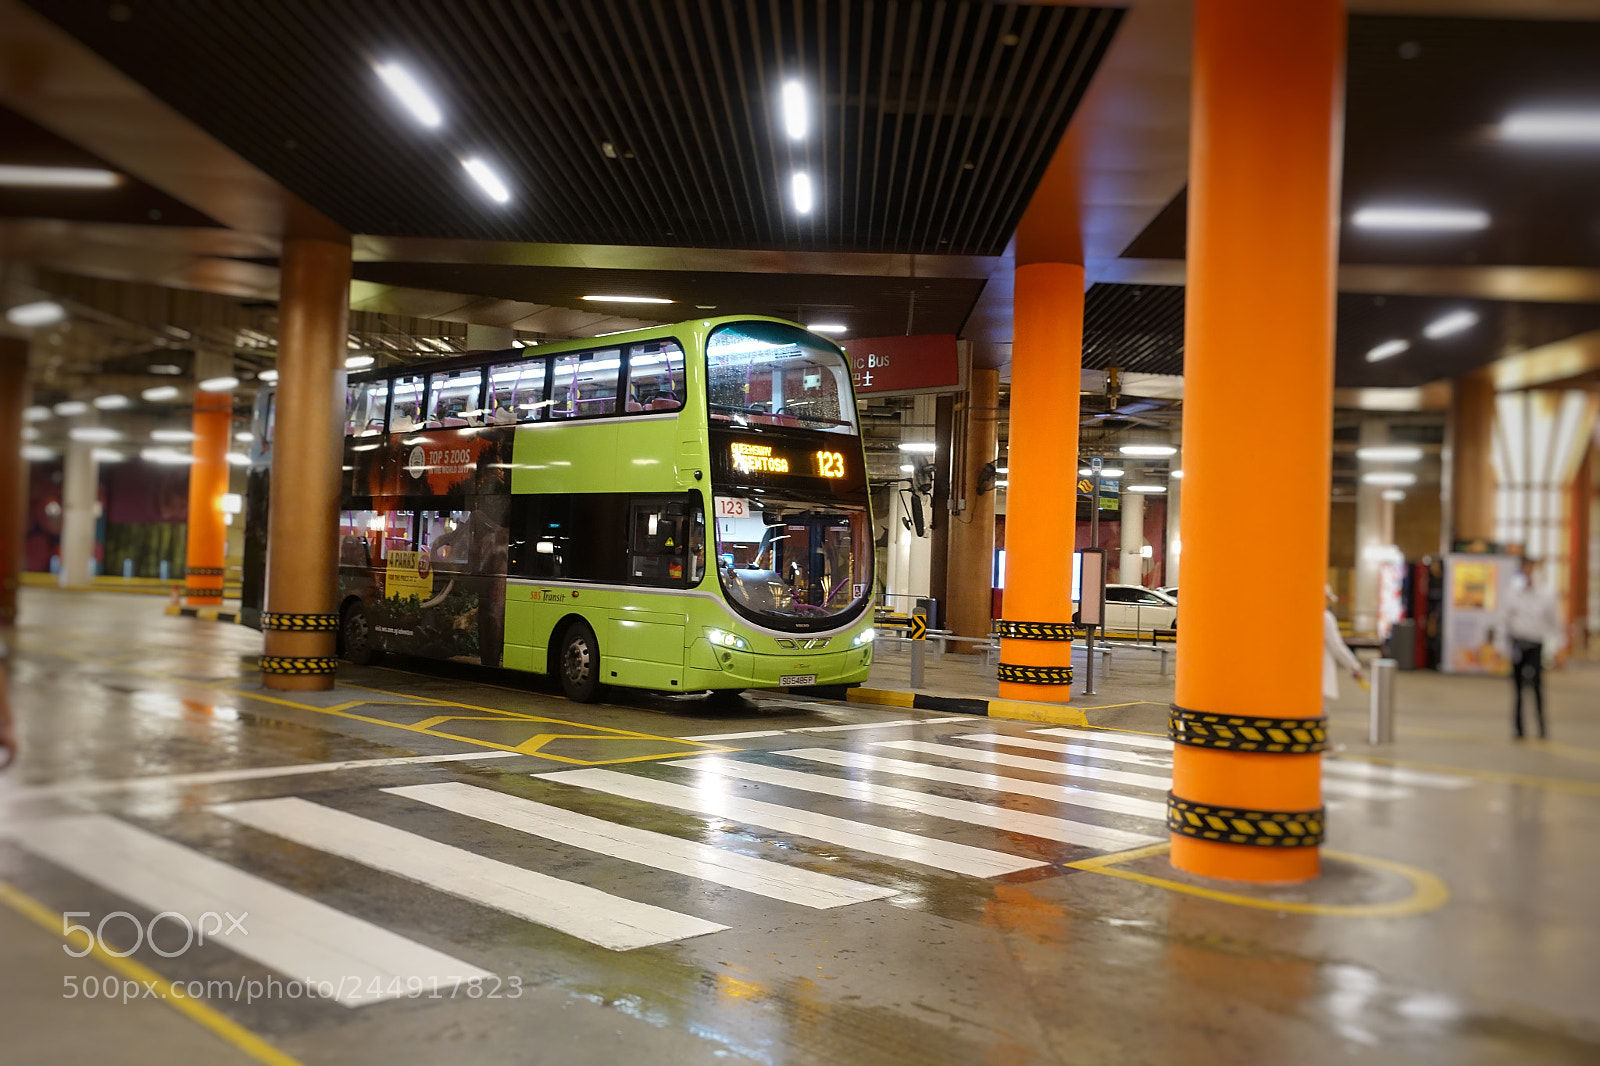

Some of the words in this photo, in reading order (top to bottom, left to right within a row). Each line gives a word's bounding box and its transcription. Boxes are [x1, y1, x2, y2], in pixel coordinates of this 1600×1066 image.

[851, 355, 865, 369] lic
[868, 353, 890, 368] Bus
[429, 450, 443, 465] TOP
[444, 450, 449, 464] 5
[450, 449, 471, 464] ZOOS
[816, 451, 845, 477] 123
[720, 500, 743, 515] 123
[389, 552, 394, 568] 4
[394, 552, 416, 569] PARKS
[530, 590, 541, 601] SBS
[541, 589, 565, 602] Transit
